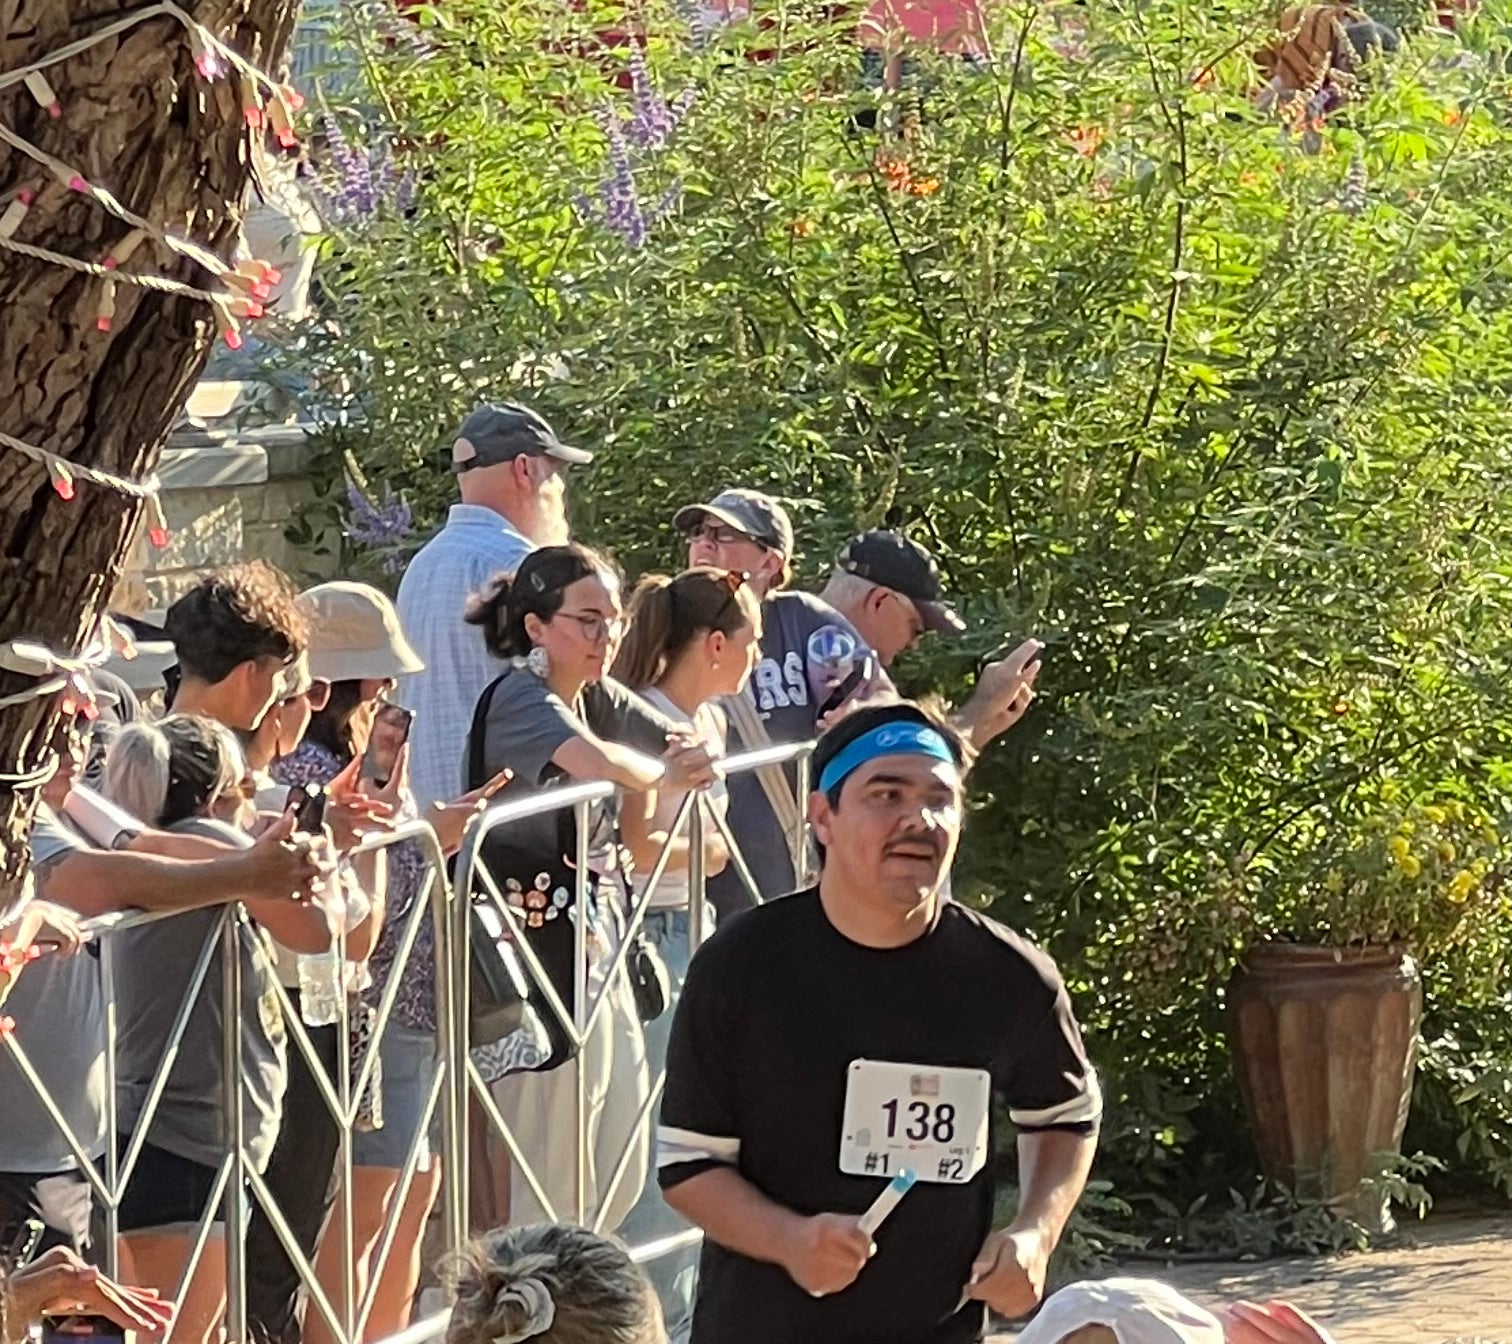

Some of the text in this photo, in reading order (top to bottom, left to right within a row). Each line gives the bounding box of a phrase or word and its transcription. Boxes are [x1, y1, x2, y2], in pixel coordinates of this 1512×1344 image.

[882, 1098, 955, 1143] 138
[864, 1151, 889, 1174] #1
[938, 1158, 963, 1180] #2
